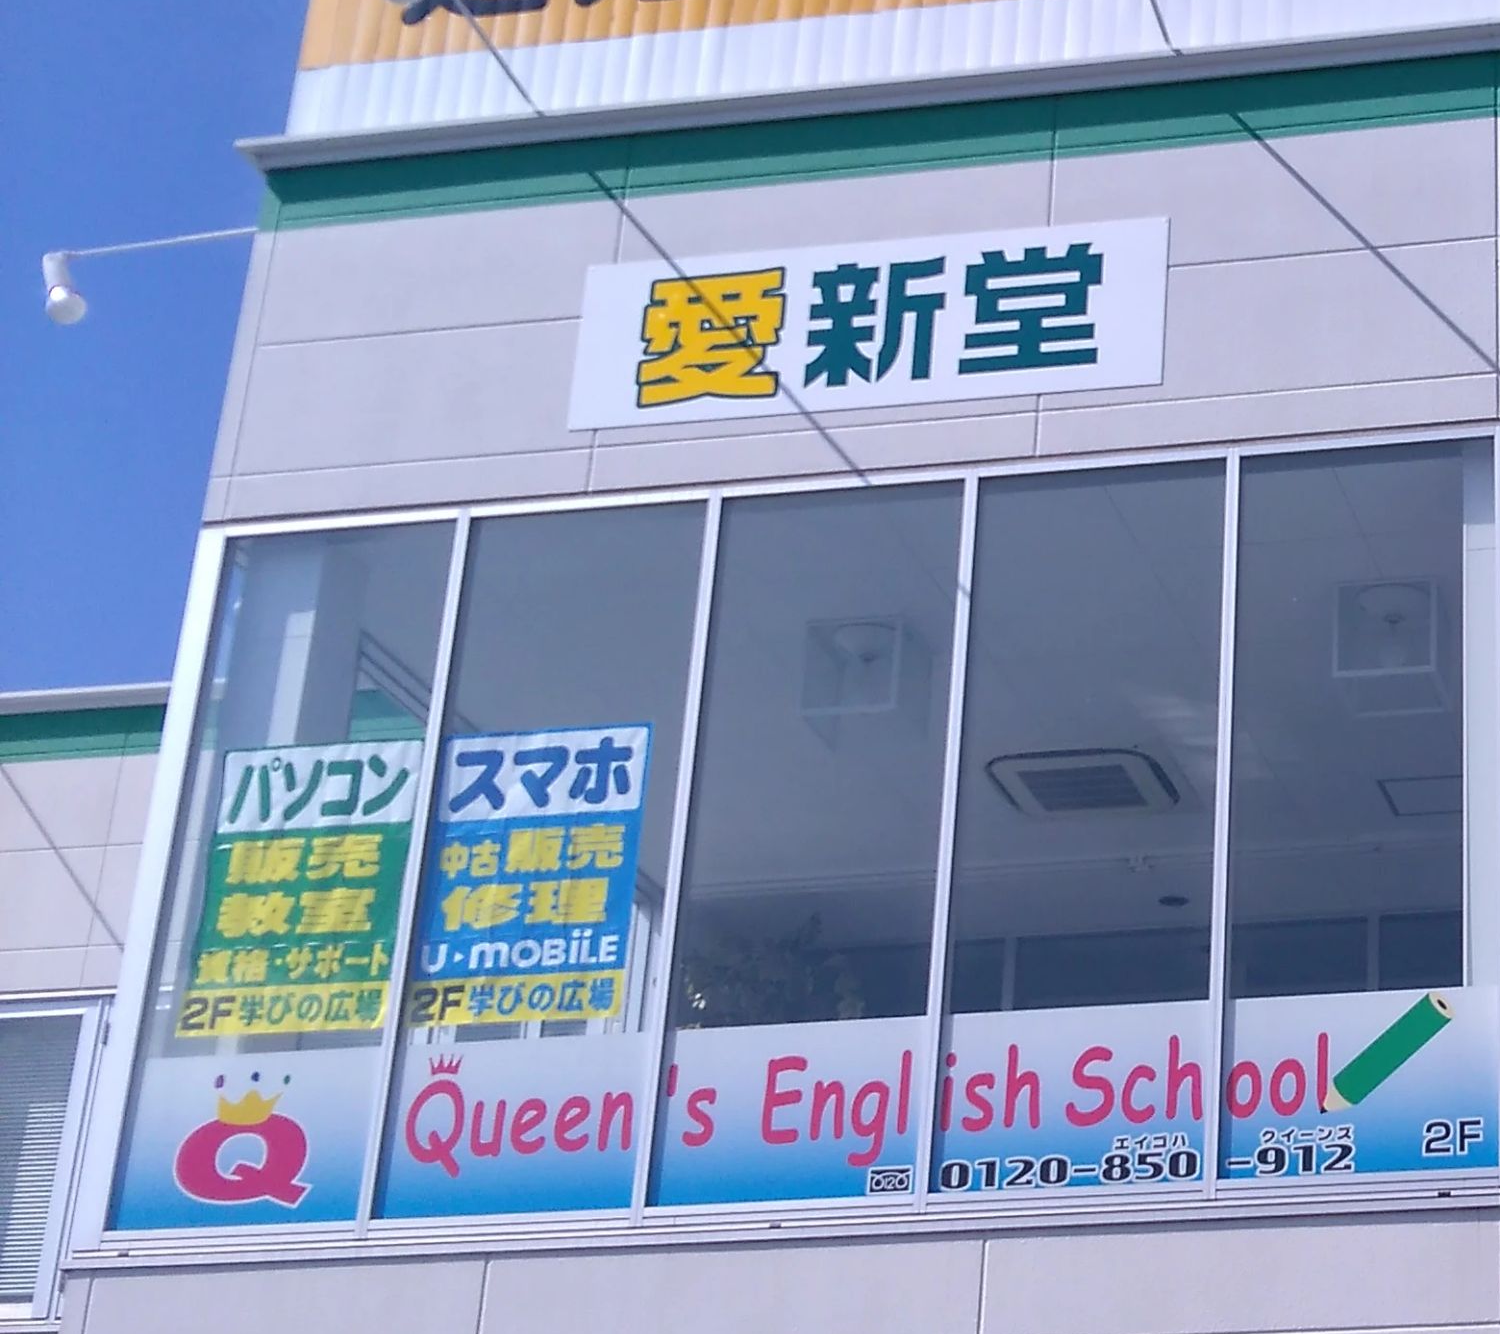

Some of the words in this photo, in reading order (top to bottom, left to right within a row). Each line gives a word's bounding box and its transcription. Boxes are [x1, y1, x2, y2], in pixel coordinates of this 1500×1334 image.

[637, 242, 1104, 408] 愛新堂
[228, 754, 409, 824] パソコン
[449, 736, 633, 814] スマホ
[440, 822, 626, 880] 中古販売
[442, 877, 609, 932] 修理
[405, 1063, 717, 1177] Queen's
[761, 1043, 1042, 1168] English
[1065, 1032, 1330, 1132] School
[1114, 1134, 1187, 1151] エイゴハ
[1261, 1125, 1354, 1145] クイーンズ
[1423, 1118, 1484, 1157] 2F
